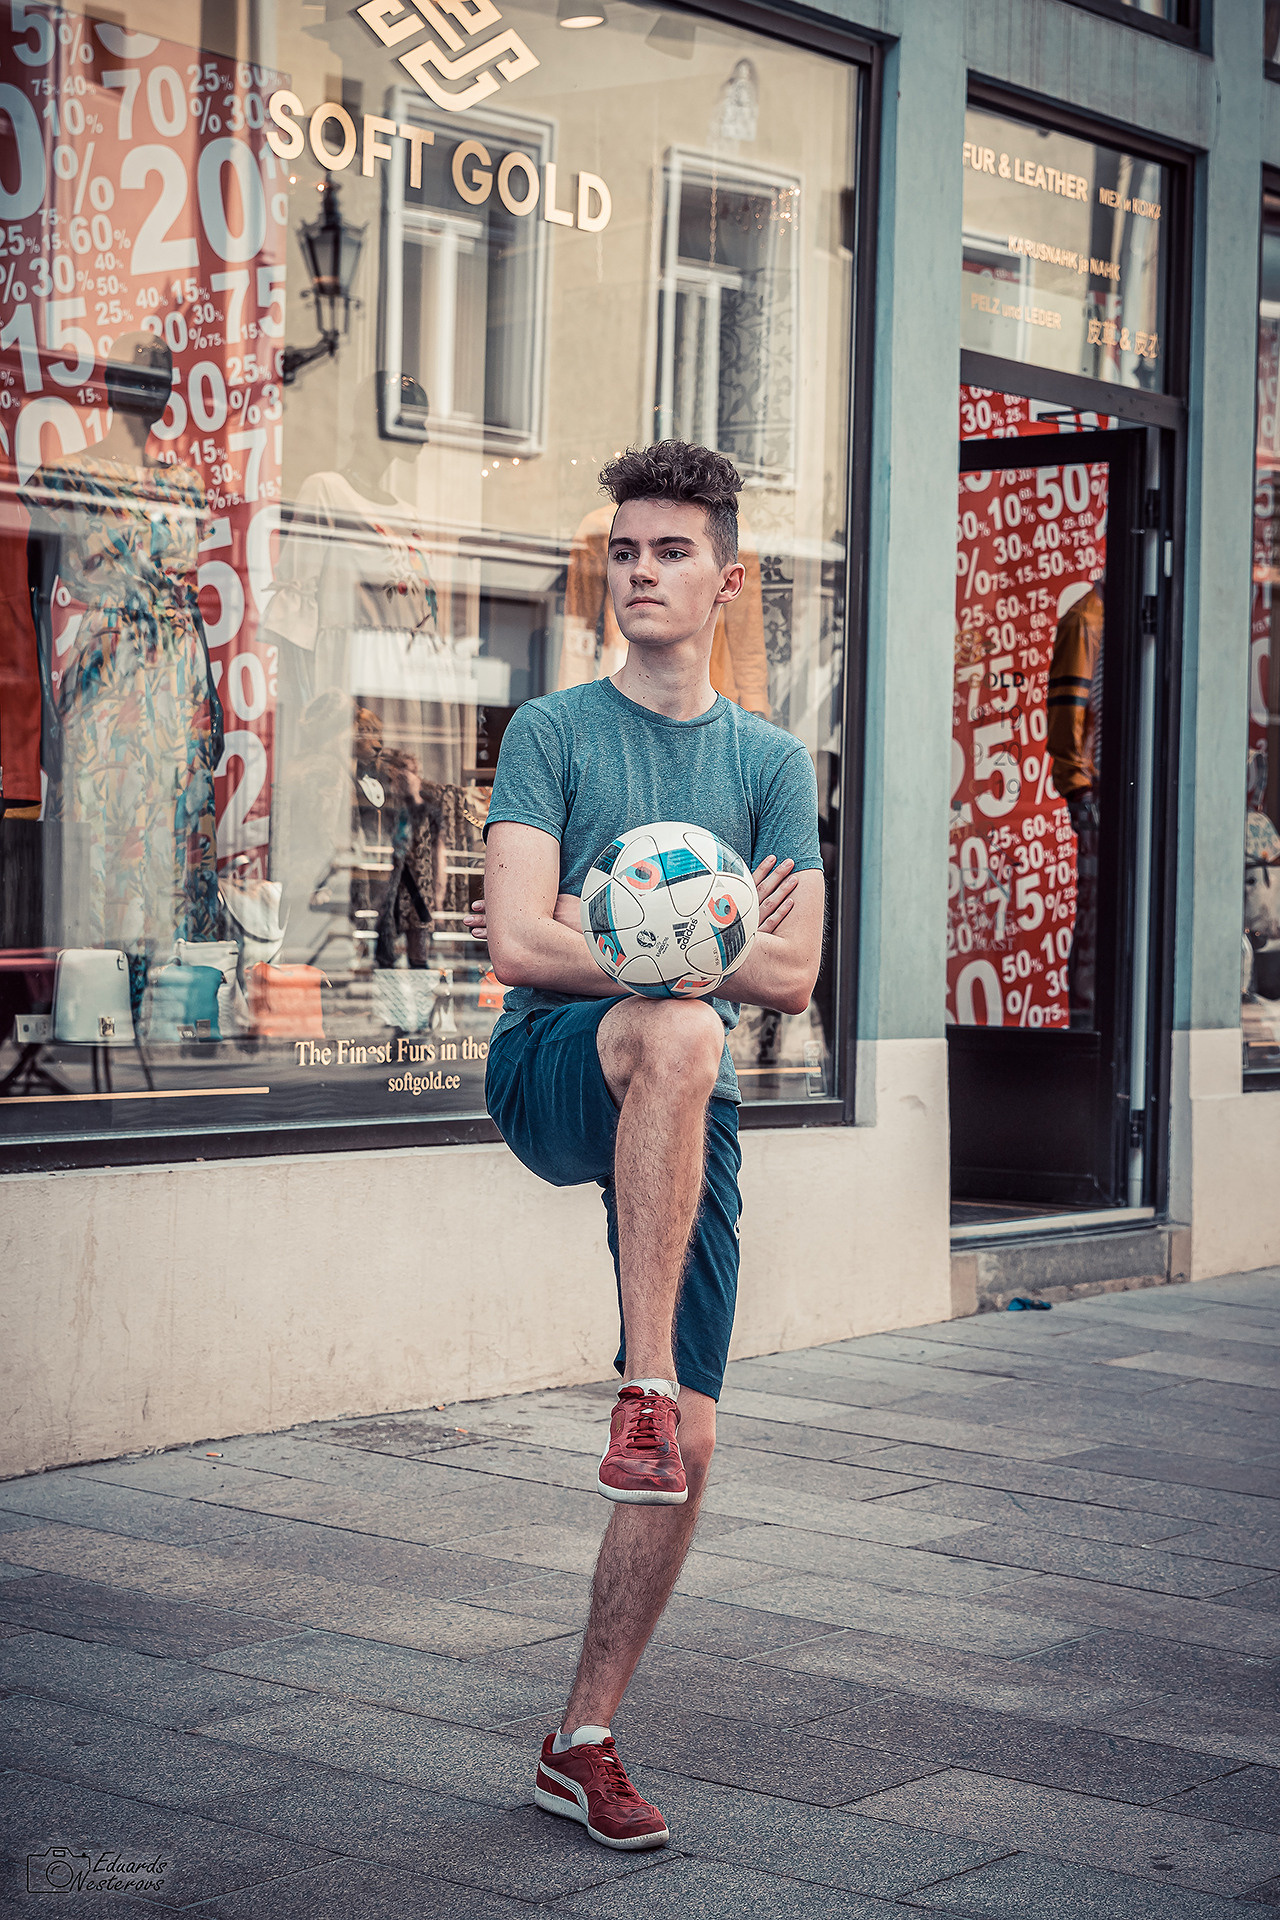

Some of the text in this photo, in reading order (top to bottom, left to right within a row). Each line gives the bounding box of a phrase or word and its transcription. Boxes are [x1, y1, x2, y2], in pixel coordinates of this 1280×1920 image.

[62, 75, 96, 96] 40%
[187, 63, 234, 93] 25%
[42, 98, 103, 137] 10%
[222, 93, 270, 132] 30
[266, 89, 612, 233] SOFT GOLD
[963, 142, 1088, 202] FUR & LEATHER
[70, 214, 131, 254] 60%
[95, 252, 124, 271] 40%
[1008, 235, 1078, 270] KARUSNAHK
[1090, 257, 1121, 281] NAHK
[29, 255, 94, 297] 30%
[97, 275, 128, 296] 50%
[136, 287, 168, 308] 40%
[171, 278, 210, 304] 15%
[94, 300, 134, 326] 25%
[193, 303, 223, 324] 30%
[971, 292, 1062, 329] PELZ und LEDER
[226, 354, 272, 386] 25%
[78, 388, 102, 404] 15%
[961, 400, 1004, 433] 30%
[189, 438, 228, 466] 15%
[210, 462, 242, 485] 30%
[987, 492, 1036, 530] 10%
[992, 532, 1034, 565] 30%
[1032, 521, 1072, 551] 40%
[1038, 550, 1075, 579] 50%
[1074, 546, 1105, 570] 30%
[995, 595, 1029, 621] 60%
[1026, 588, 1057, 612] 75%
[961, 604, 995, 629] 25%
[986, 622, 1029, 655] 30%
[1018, 647, 1047, 669] 70%
[1022, 814, 1054, 841] 60%
[1014, 840, 1056, 875] 30%
[1044, 860, 1078, 889] 70%
[680, 918, 698, 950] adidas
[1002, 950, 1043, 984] 50%
[295, 1036, 488, 1067] The Finest Furs in the
[388, 1071, 461, 1096] softgold.ee
